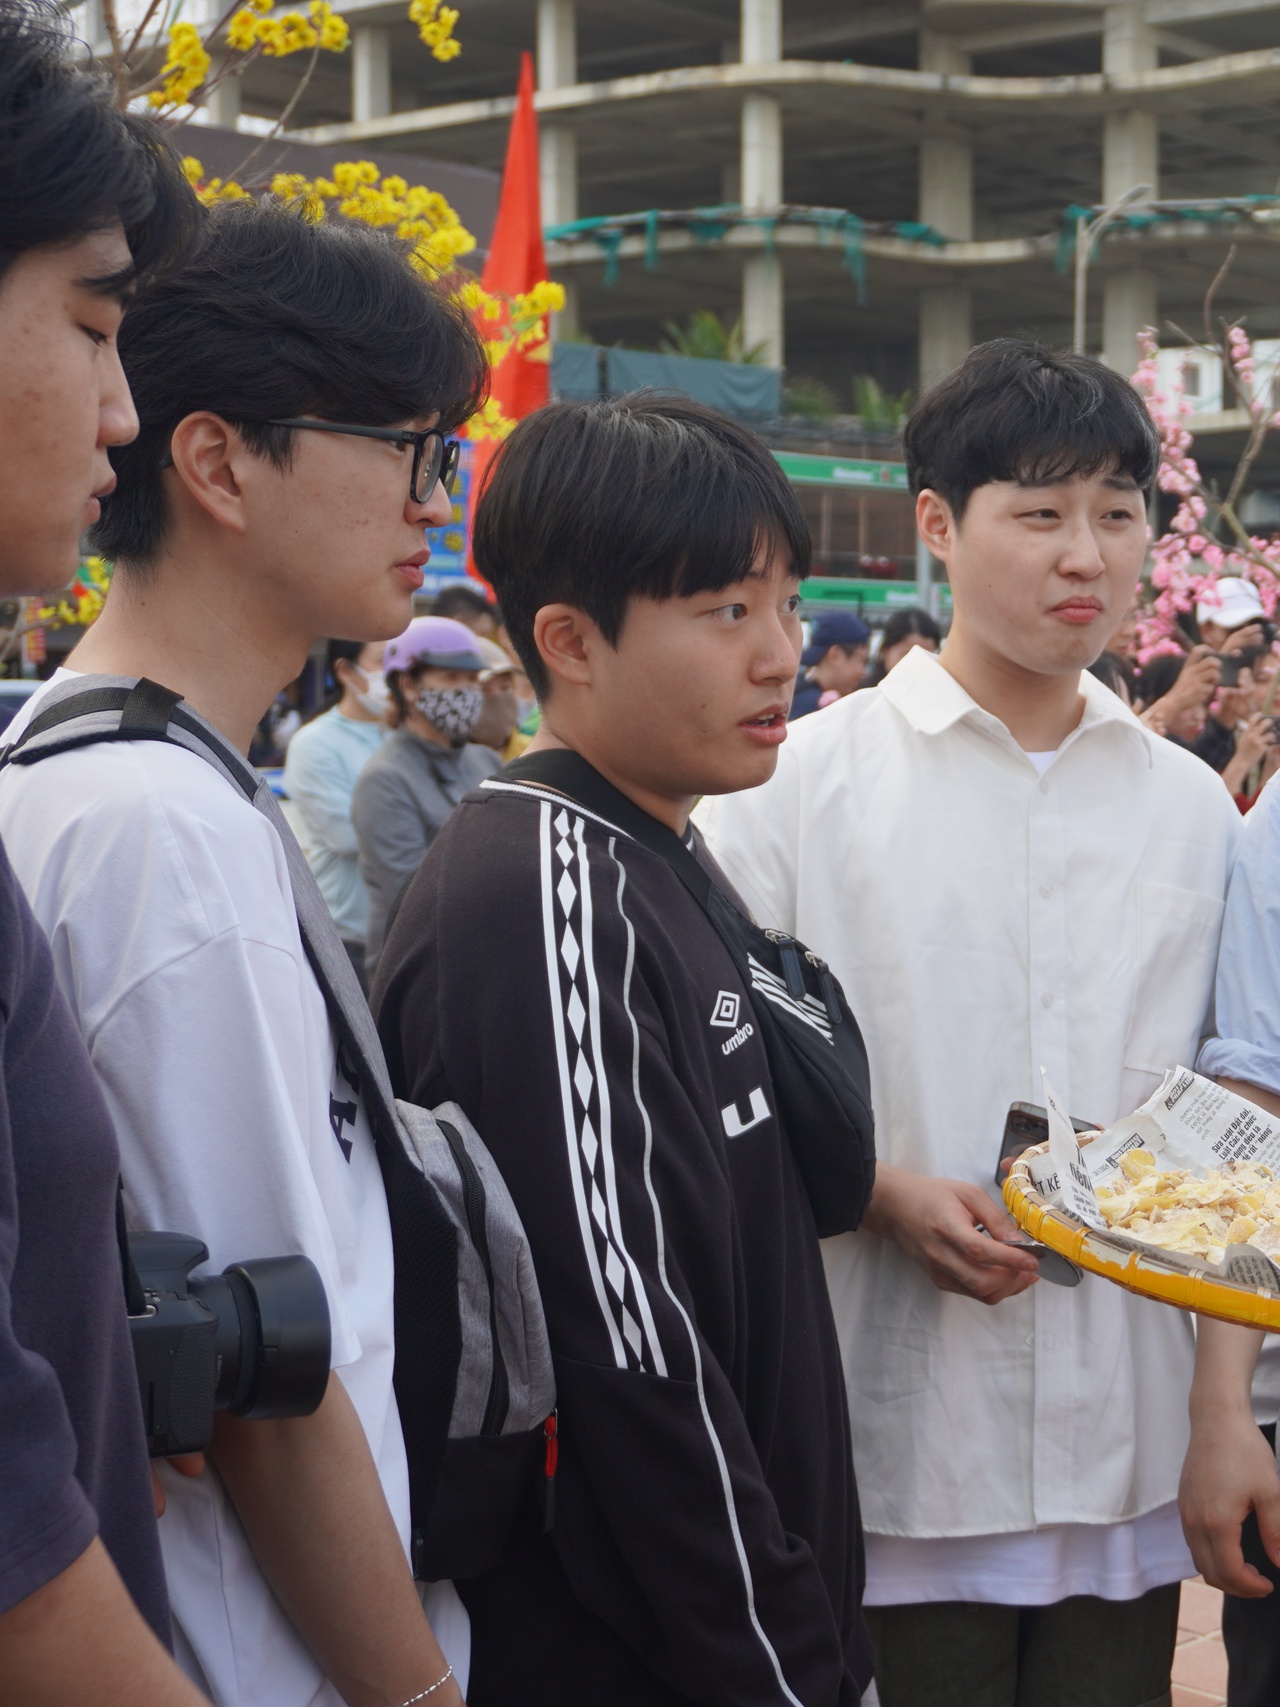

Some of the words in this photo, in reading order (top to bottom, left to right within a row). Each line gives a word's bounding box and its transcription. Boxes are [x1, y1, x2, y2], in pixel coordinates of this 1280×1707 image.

[721, 1023, 754, 1055] umbro
[1209, 1138, 1224, 1153] Sửa
[1219, 1127, 1235, 1143] Luật
[1228, 1115, 1243, 1130] Đất
[1217, 1144, 1233, 1161] Luật
[1226, 1133, 1240, 1147] Các
[1240, 1113, 1258, 1130] chức
[1232, 1143, 1248, 1159] dụng
[1240, 1130, 1256, 1145] đều
[1252, 1124, 1261, 1133] là
[1245, 1143, 1258, 1155] rất
